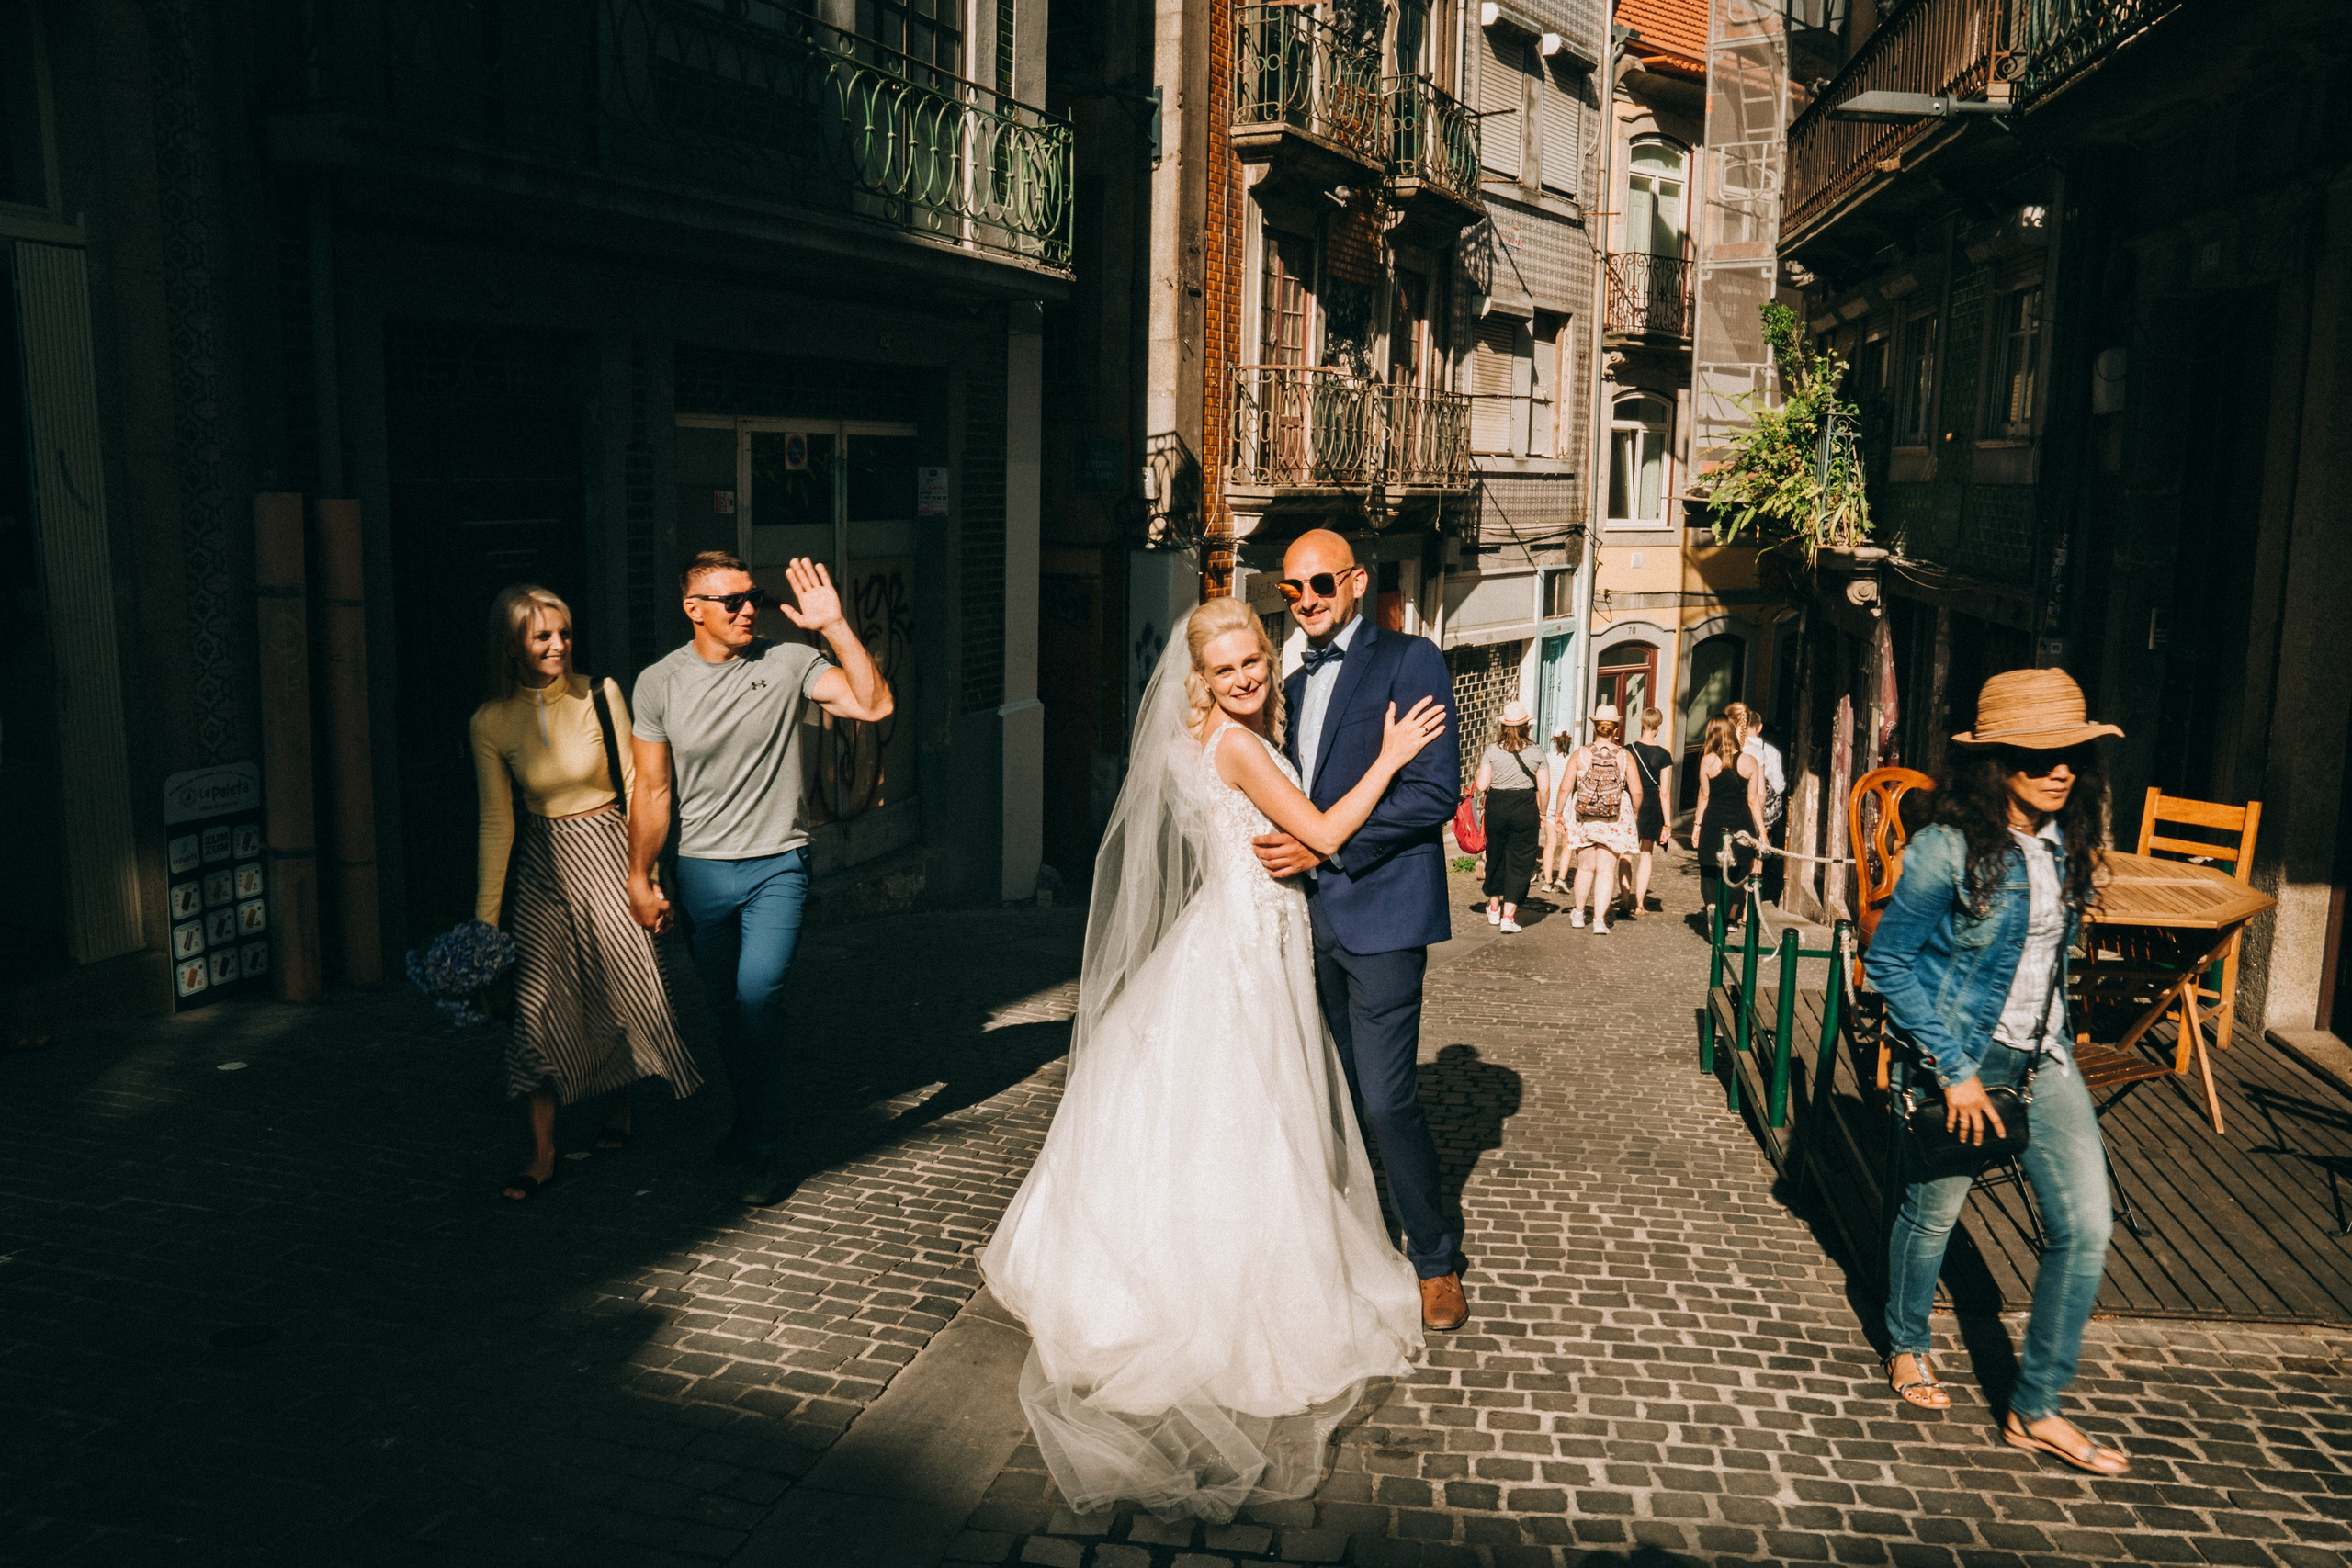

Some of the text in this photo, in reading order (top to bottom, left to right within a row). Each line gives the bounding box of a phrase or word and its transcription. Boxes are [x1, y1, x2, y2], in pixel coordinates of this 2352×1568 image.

[1628, 626, 1636, 635] 70
[199, 788, 210, 800] La
[211, 779, 249, 801] Paleta
[205, 831, 229, 845] ZUM
[205, 842, 229, 855] ZUM
